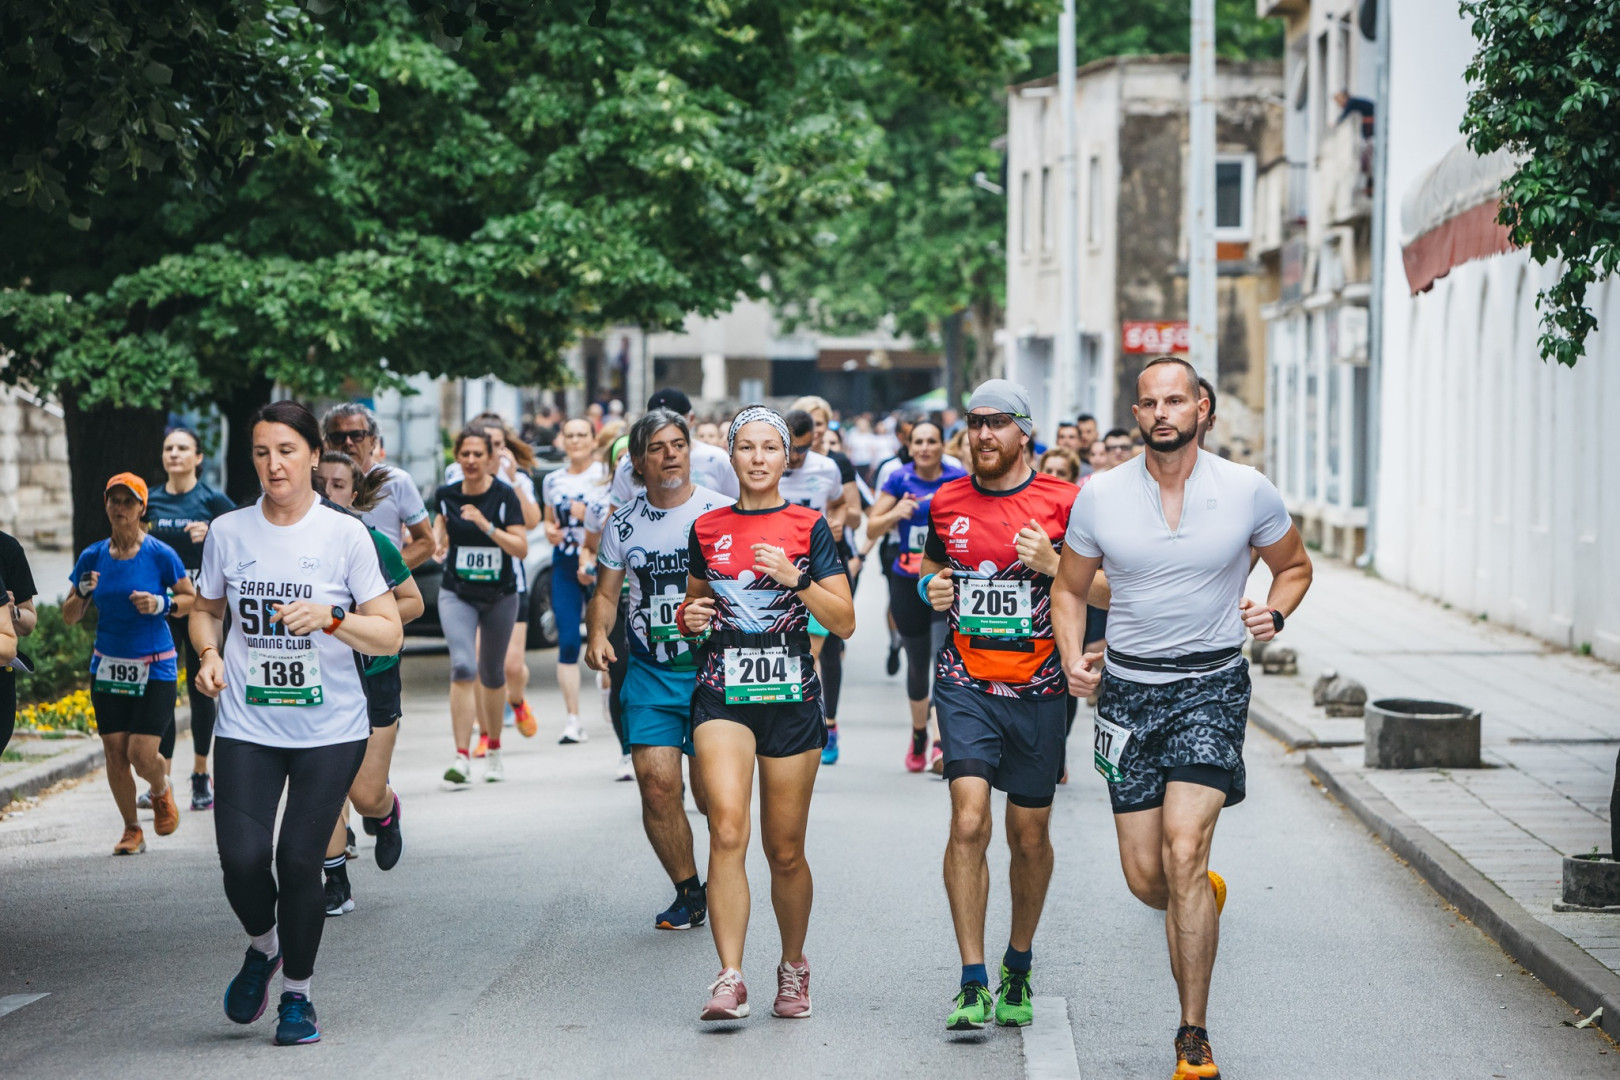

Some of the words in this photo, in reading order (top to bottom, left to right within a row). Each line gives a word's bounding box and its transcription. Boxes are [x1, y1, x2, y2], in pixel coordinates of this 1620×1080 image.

[466, 553, 492, 568] 081
[240, 580, 312, 599] SARAJEVO
[971, 589, 1017, 616] 205
[246, 637, 282, 650] UNNING
[286, 639, 311, 650] CLUB
[108, 664, 138, 682] 193
[261, 661, 305, 687] 138
[739, 656, 787, 683] 204
[1094, 724, 1113, 759] 217
